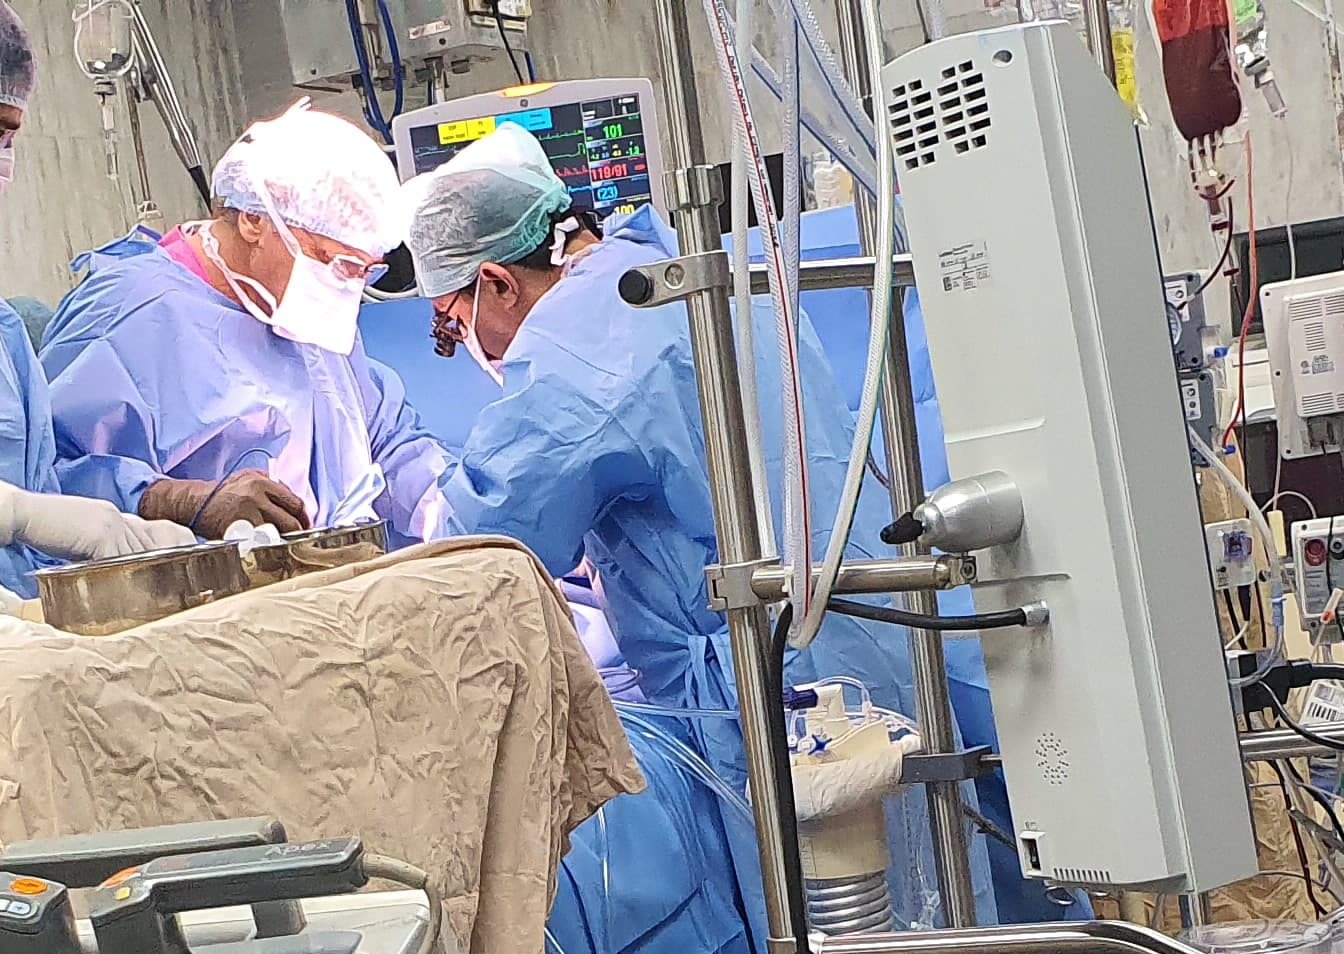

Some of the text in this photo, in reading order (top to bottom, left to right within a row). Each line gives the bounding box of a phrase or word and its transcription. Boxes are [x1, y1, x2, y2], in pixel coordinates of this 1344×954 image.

[603, 124, 623, 139] 101
[592, 164, 627, 180] 119/91
[598, 186, 618, 200] (23)
